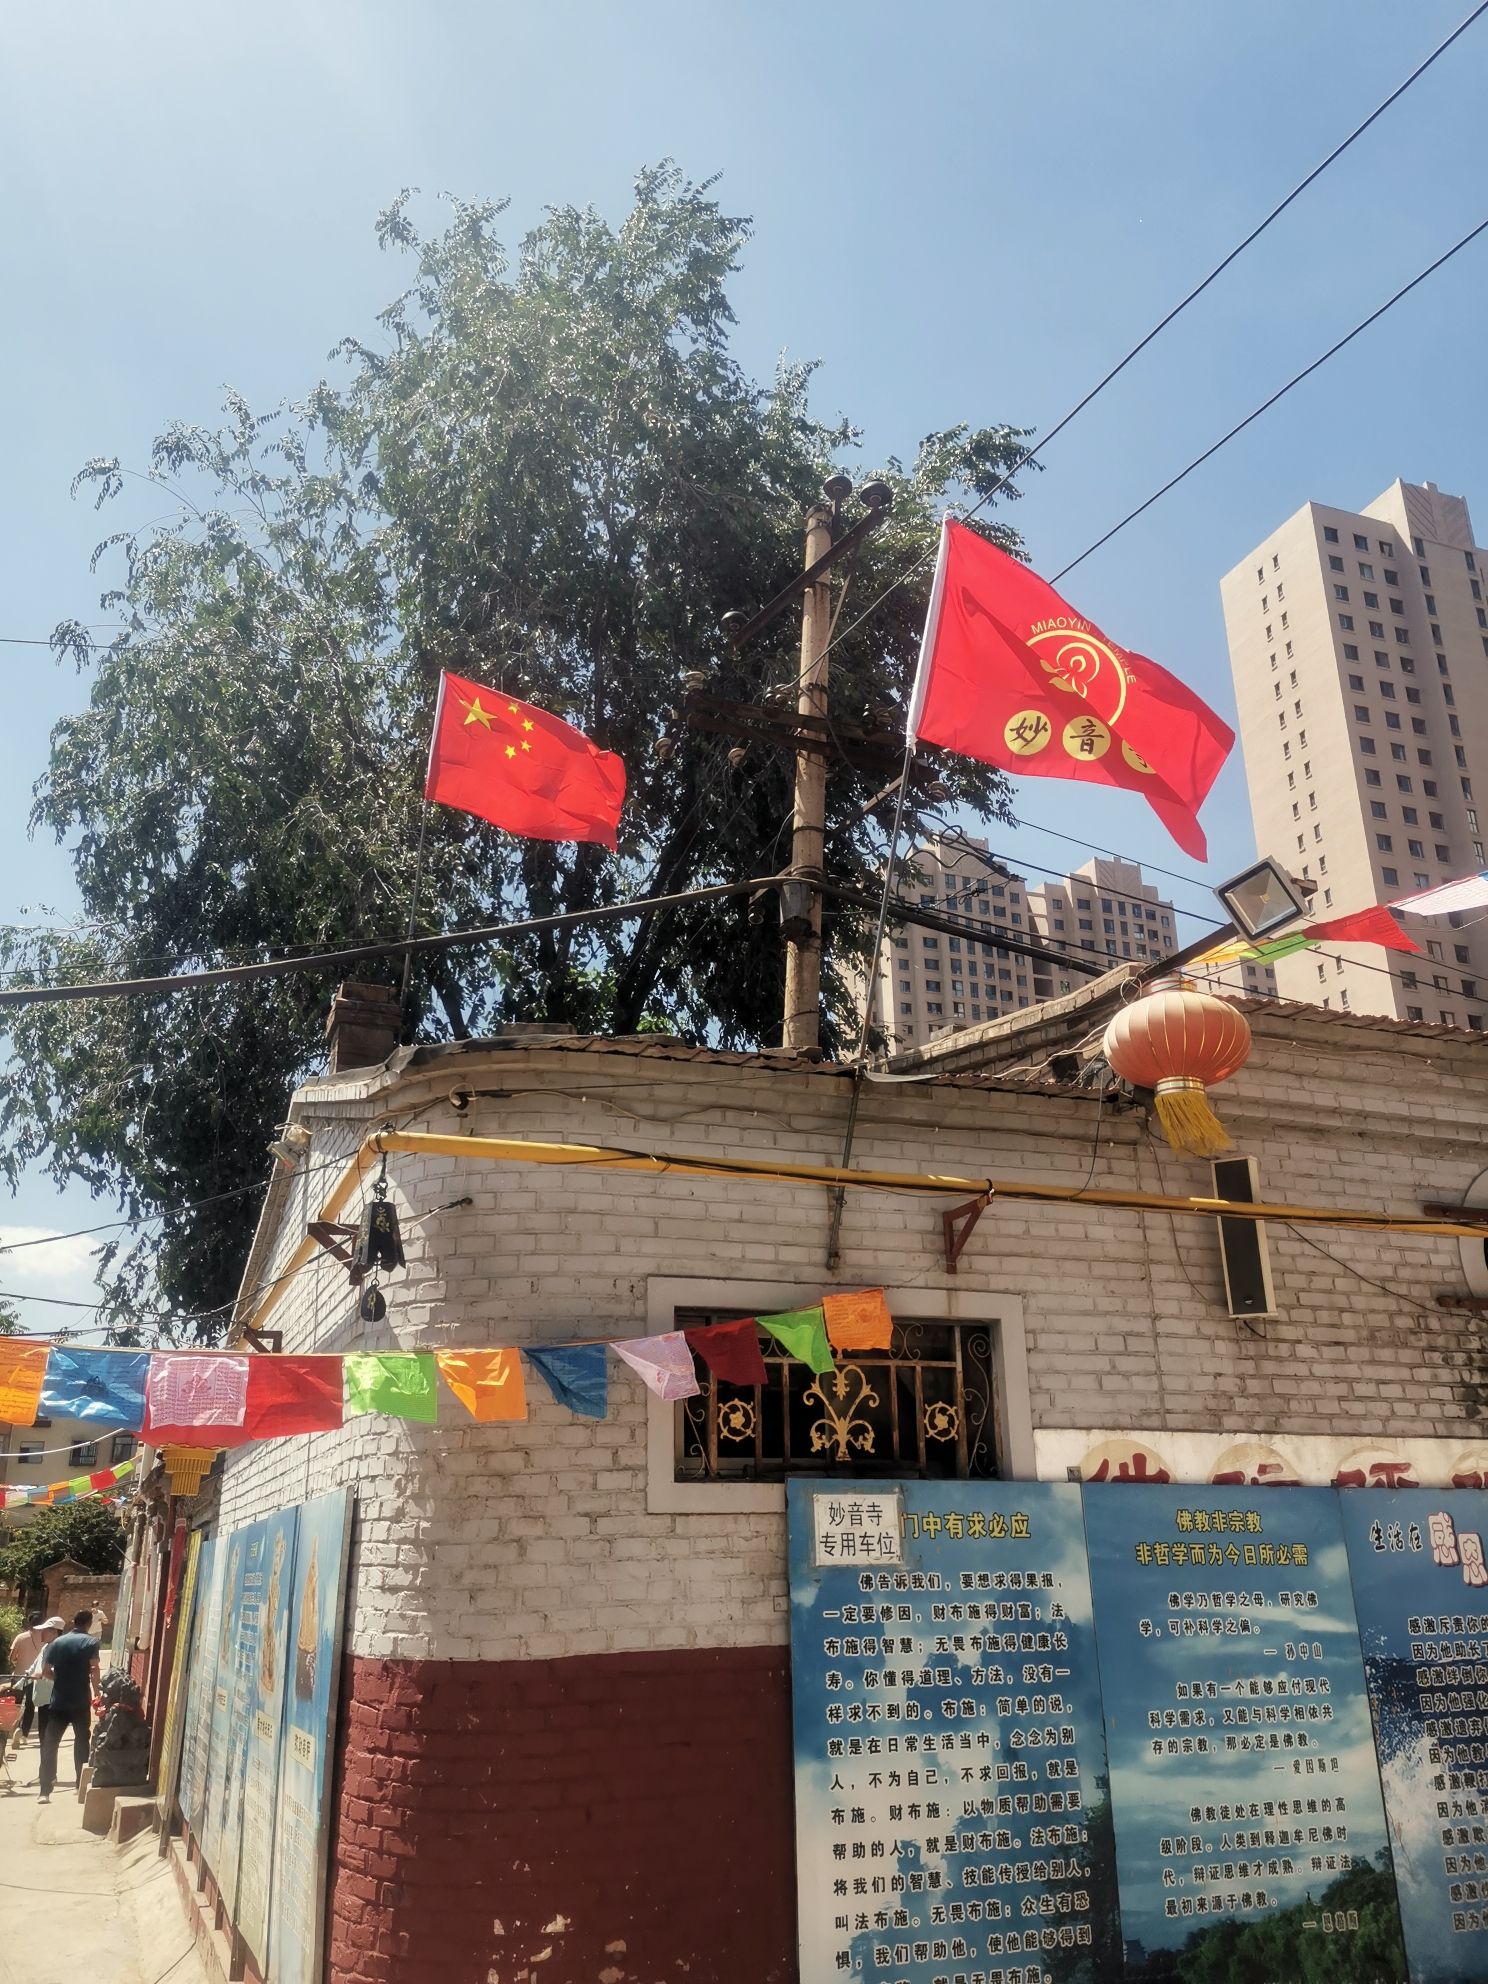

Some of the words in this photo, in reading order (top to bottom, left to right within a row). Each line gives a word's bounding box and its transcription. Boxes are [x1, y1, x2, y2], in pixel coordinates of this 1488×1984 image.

[1030, 616, 1092, 635] MIAOYIN
[828, 1502, 883, 1527] 妙音寺
[901, 1512, 1032, 1539] 门中有求必应
[1176, 1510, 1263, 1533] 佛教非宗教
[819, 1532, 895, 1557] 专用车位
[1135, 1543, 1309, 1566] 非哲学而为今日所必需
[1176, 1677, 1331, 1699] 如果有一个能够应付现代
[1190, 1797, 1347, 1823] 佛教徒处在理性思维的高
